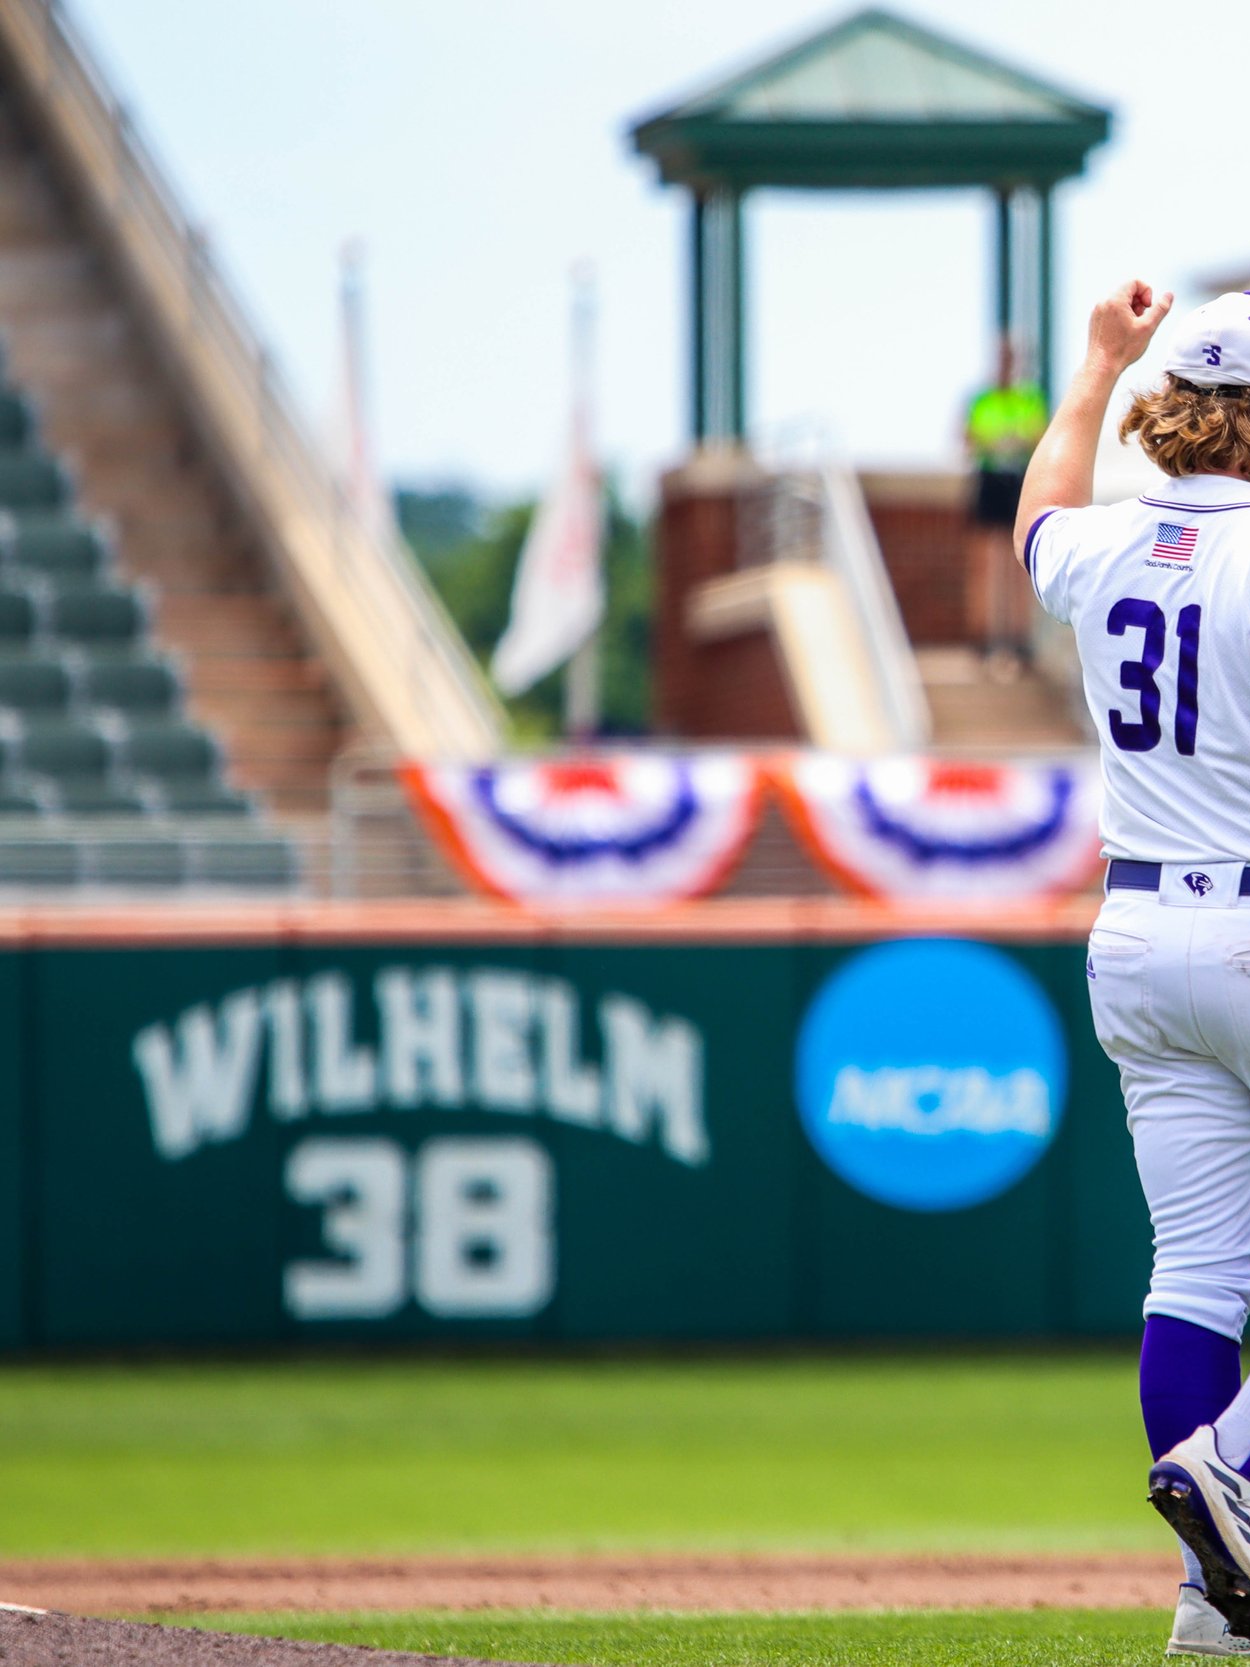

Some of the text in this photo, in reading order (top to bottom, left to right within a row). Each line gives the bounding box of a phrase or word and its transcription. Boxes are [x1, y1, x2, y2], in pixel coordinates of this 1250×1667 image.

[1107, 597, 1202, 757] 31
[132, 965, 709, 1168] WILHELM
[826, 1064, 1053, 1138] NCAA
[282, 1135, 558, 1321] 38
